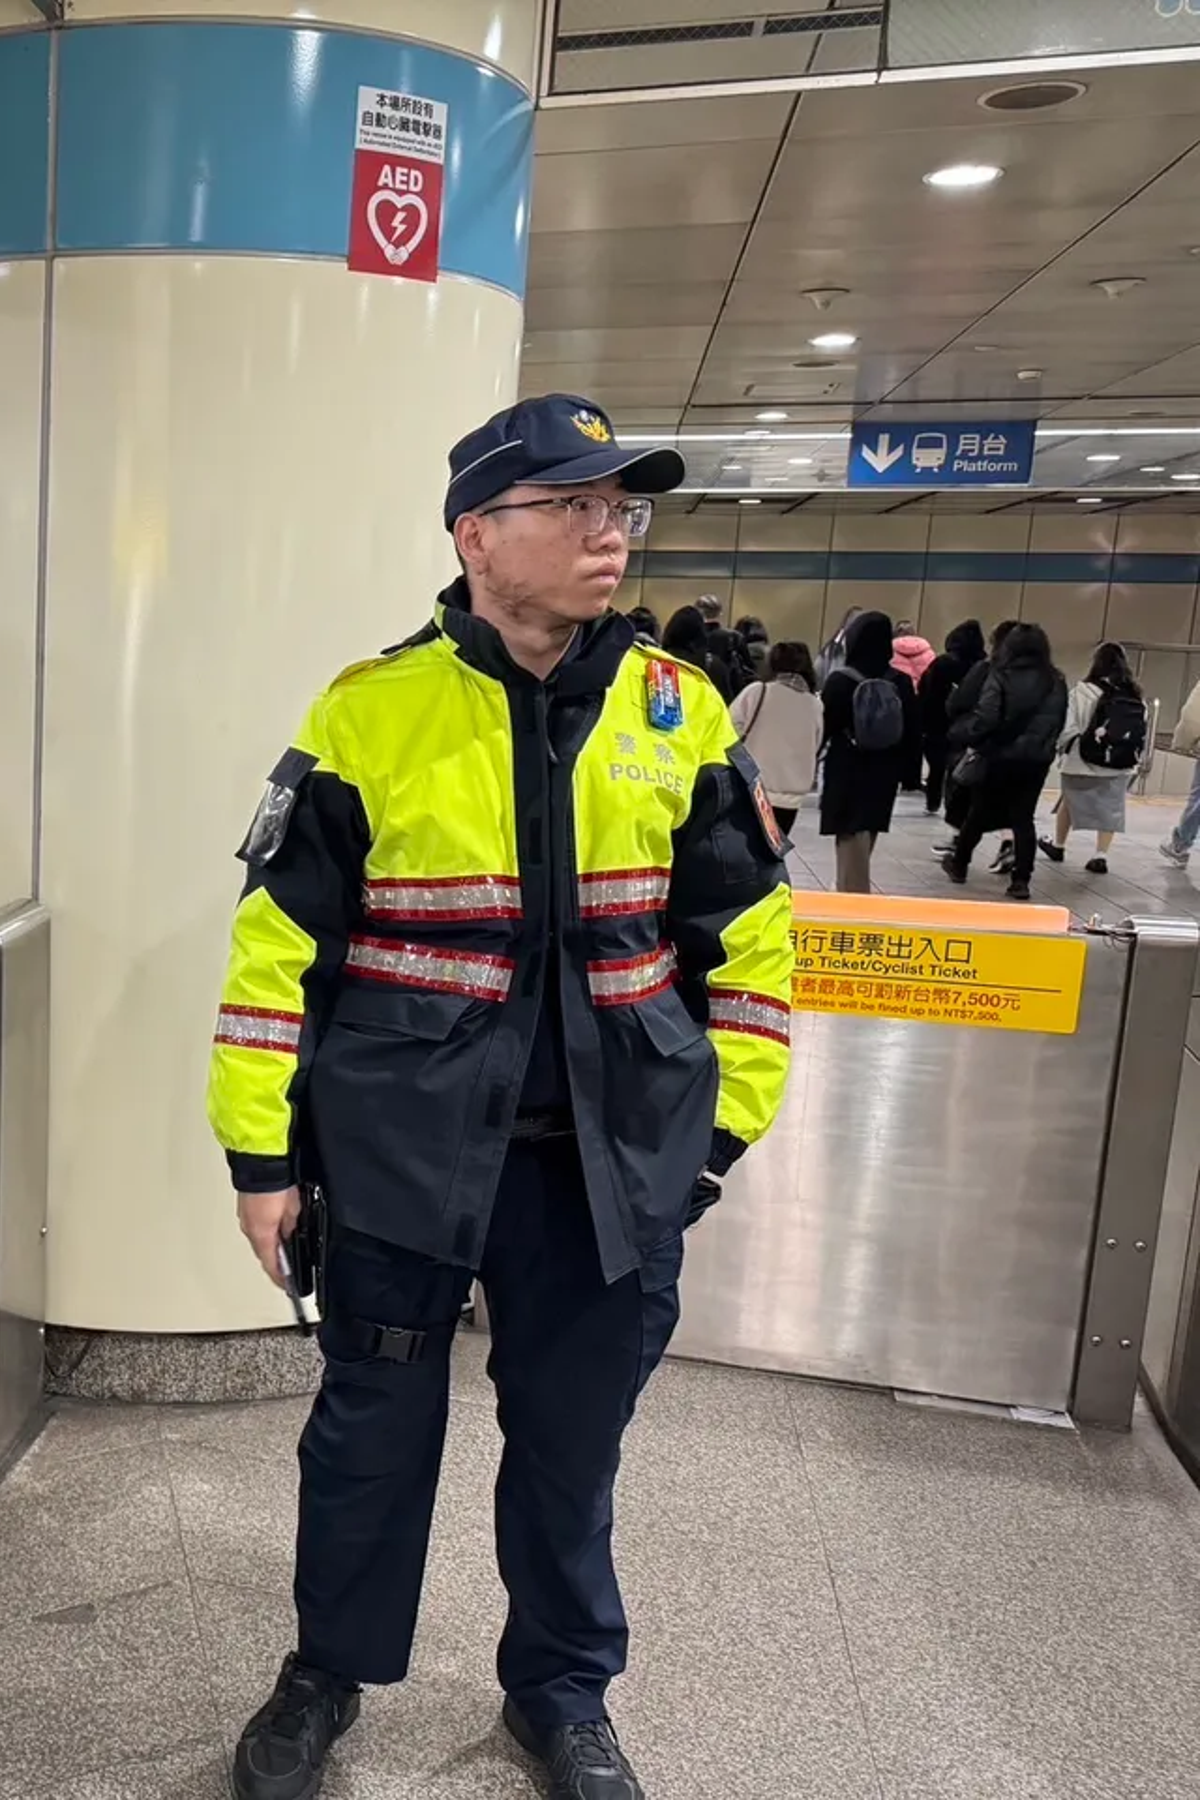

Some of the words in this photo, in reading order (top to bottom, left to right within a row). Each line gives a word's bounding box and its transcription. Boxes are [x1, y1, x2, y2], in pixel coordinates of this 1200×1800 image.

[375, 93, 434, 119] 本場所設有
[377, 164, 423, 192] AED
[955, 432, 1008, 457] 月台
[953, 458, 1018, 473] Platform
[608, 762, 684, 796] POLICE
[818, 955, 923, 976] Ticket/Cyclist
[929, 963, 978, 979] Ticket
[839, 1000, 858, 1009] will
[860, 1001, 875, 1011] be
[878, 1002, 908, 1014] fined
[910, 1006, 926, 1016] up
[928, 1006, 940, 1016] to
